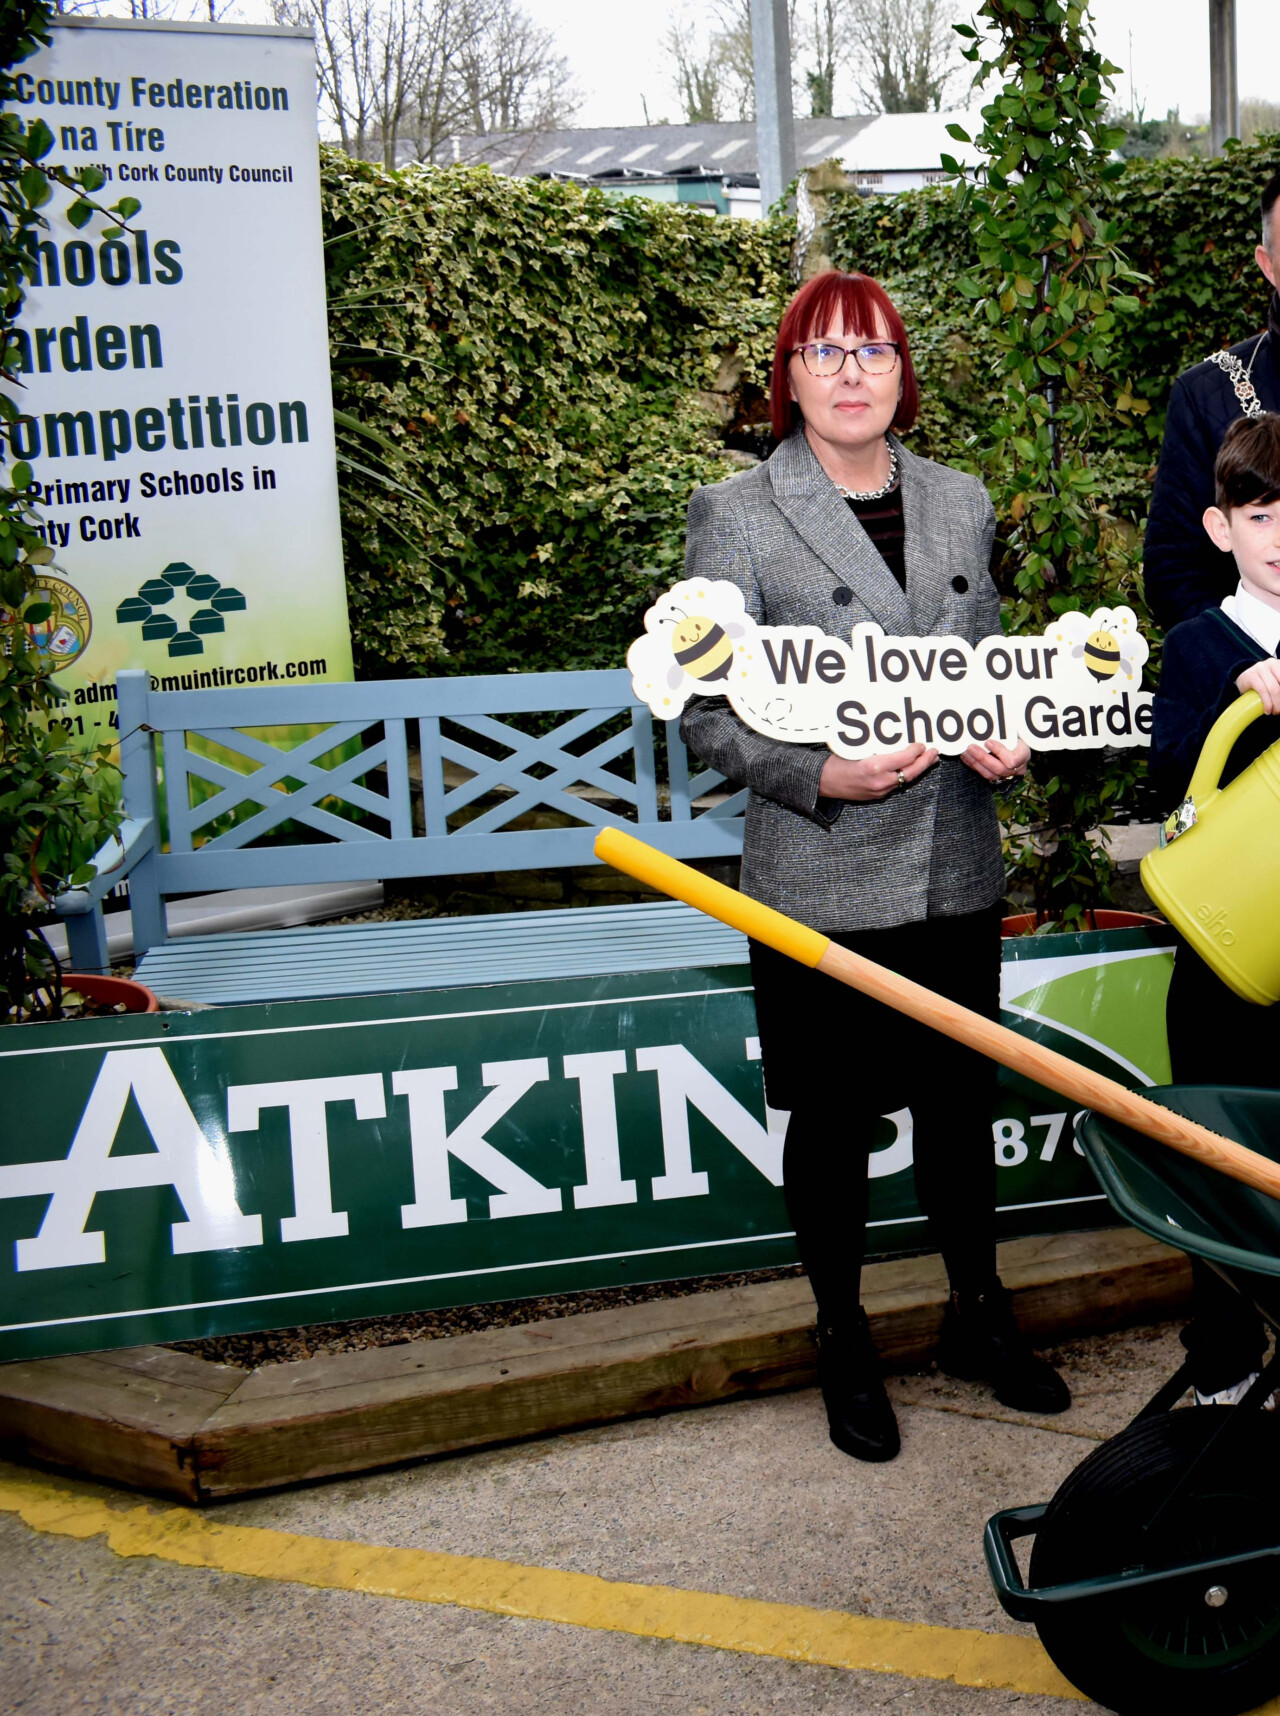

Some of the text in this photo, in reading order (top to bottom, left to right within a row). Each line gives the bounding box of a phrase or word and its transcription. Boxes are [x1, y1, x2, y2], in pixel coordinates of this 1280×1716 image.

[15, 73, 289, 111] County Federation
[60, 126, 98, 151] na
[106, 121, 165, 152] Tíre
[118, 163, 159, 181] Cork
[165, 164, 223, 184] County
[229, 165, 293, 183] Council
[8, 393, 309, 462] ompetition
[26, 466, 276, 507] Primary Schools in
[80, 512, 141, 542] Cork
[762, 635, 1058, 684] We love our
[837, 691, 1153, 747] School Garde
[1195, 904, 1236, 947] elho
